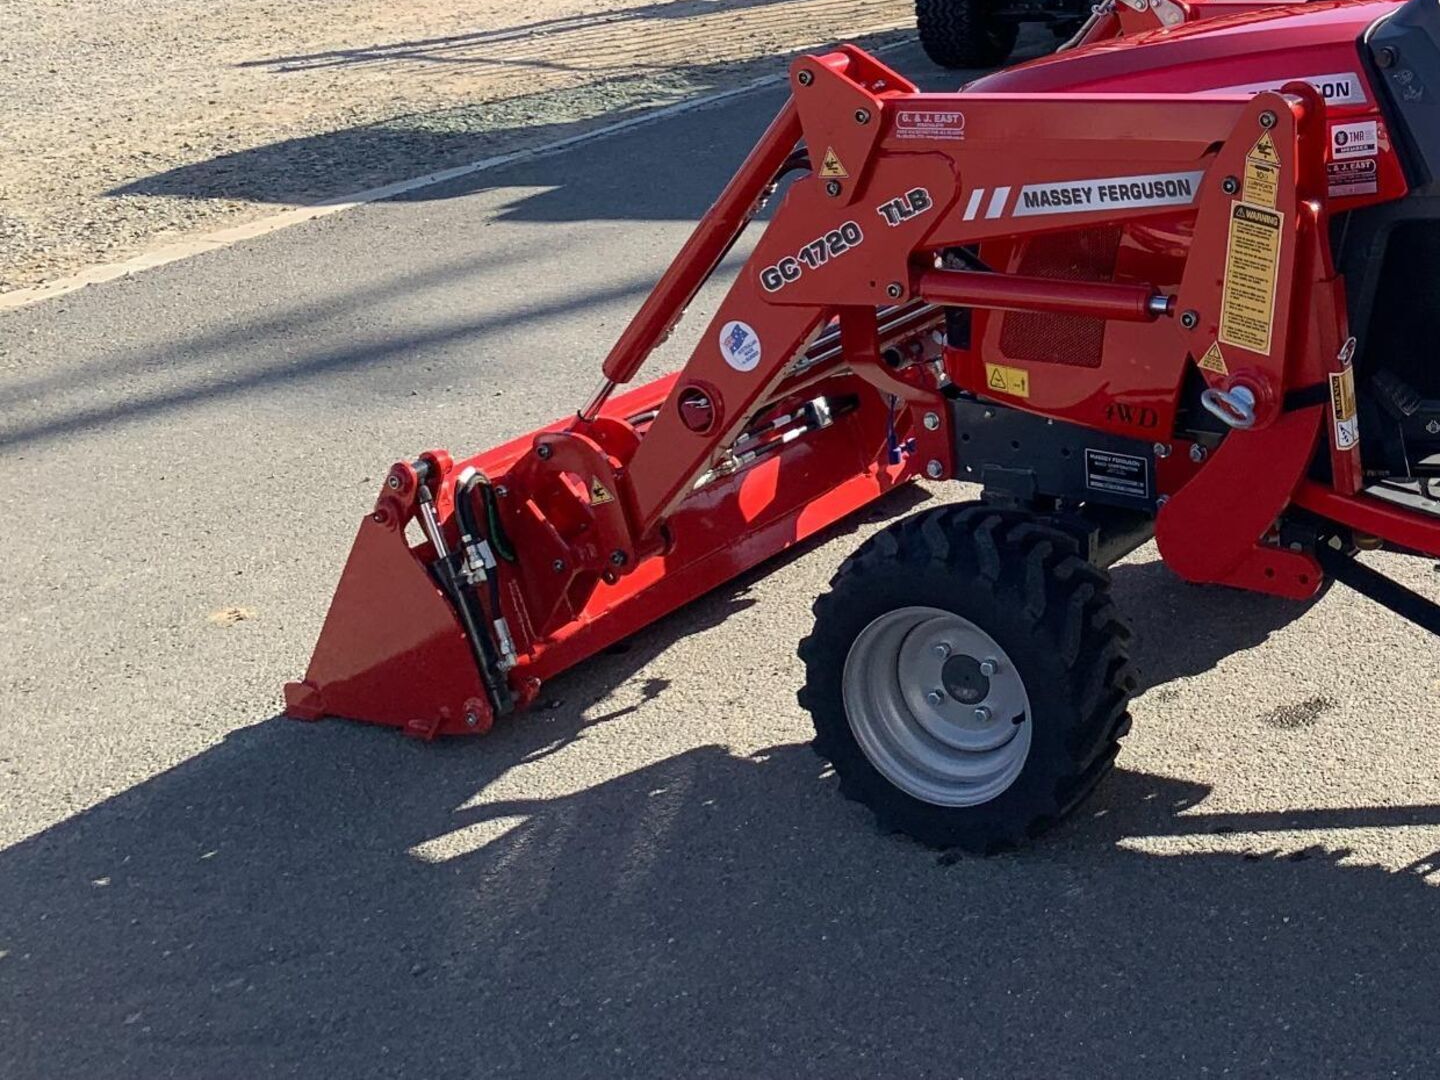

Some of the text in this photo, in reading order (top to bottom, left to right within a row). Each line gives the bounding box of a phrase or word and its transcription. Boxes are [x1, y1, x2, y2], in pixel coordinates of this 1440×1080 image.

[934, 114, 959, 123] EAST
[1349, 131, 1364, 143] TMR
[1023, 179, 1191, 208] MASSEY FERGUSON
[1246, 210, 1278, 226] WARNING
[760, 187, 933, 292] GC 1720 TLB
